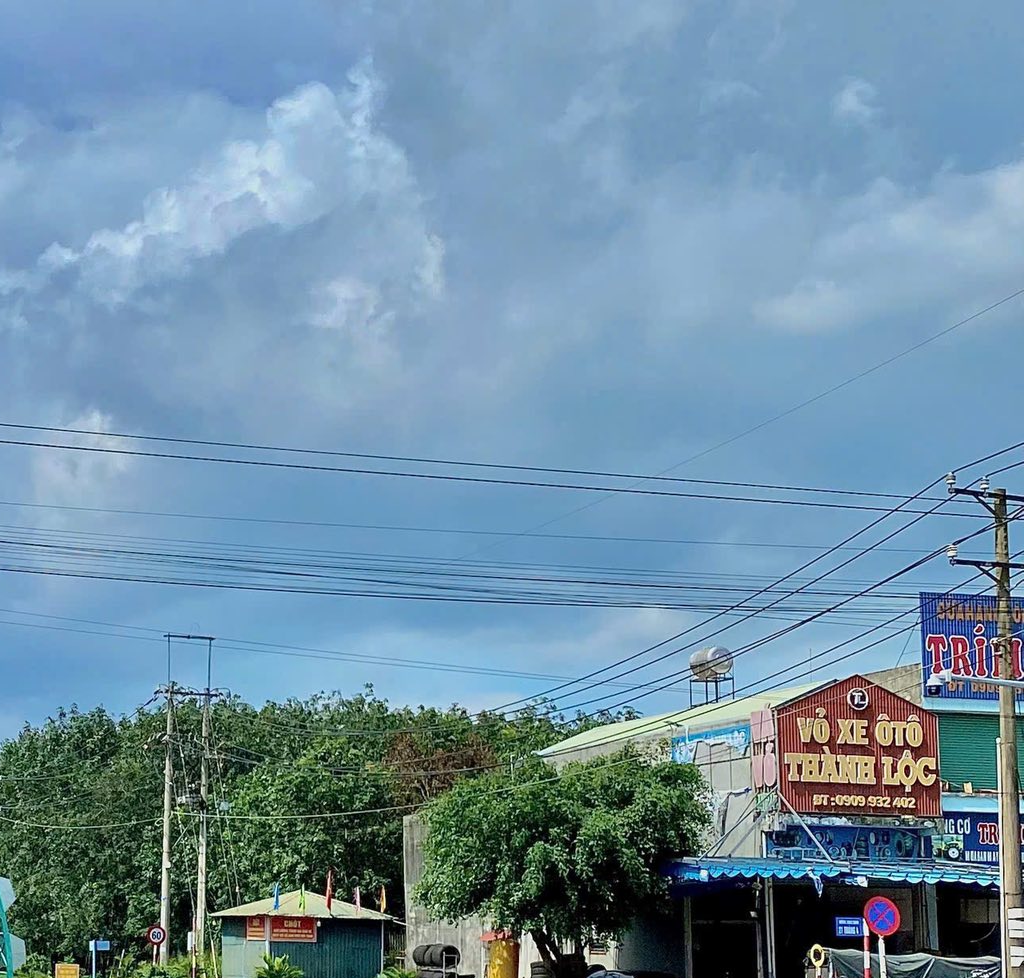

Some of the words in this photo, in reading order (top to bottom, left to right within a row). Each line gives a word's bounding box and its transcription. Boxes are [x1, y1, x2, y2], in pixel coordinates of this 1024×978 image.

[796, 707, 831, 744] VỎ
[837, 718, 870, 745] XE
[875, 713, 924, 748] ÔTÔ
[784, 745, 877, 785] THÀNH
[881, 750, 937, 793] LỘC
[867, 796, 891, 808] 932
[892, 797, 916, 809] 402
[152, 931, 162, 940] 60
